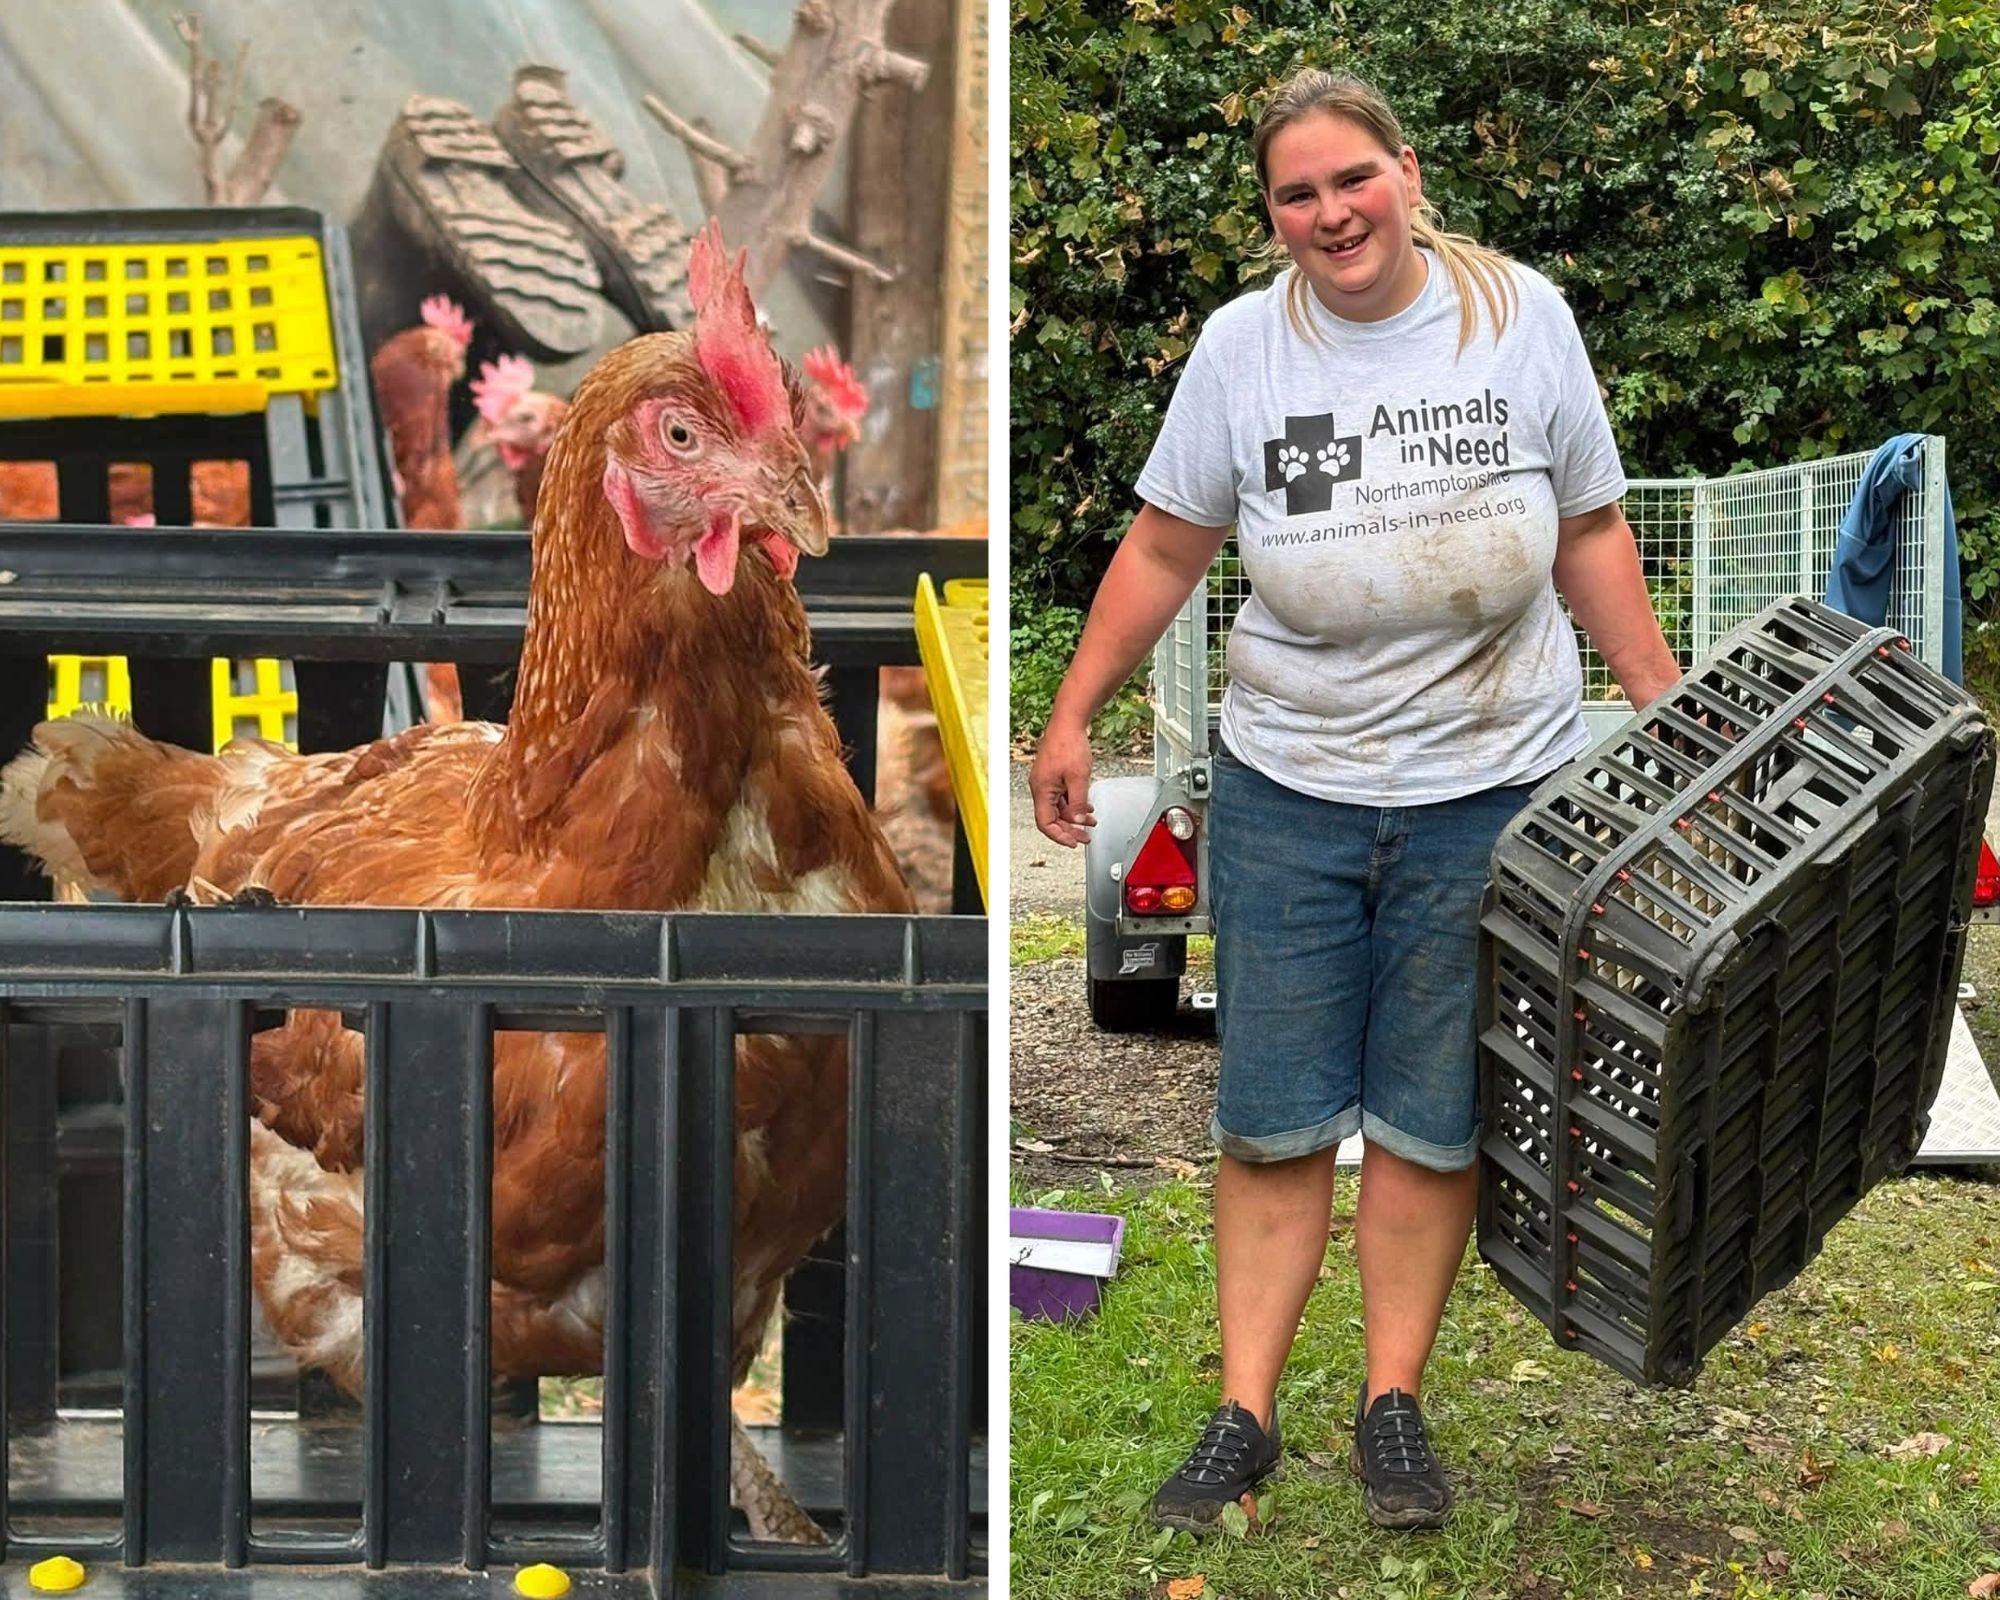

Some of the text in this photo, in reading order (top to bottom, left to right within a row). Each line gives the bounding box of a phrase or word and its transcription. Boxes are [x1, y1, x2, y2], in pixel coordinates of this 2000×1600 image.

[1369, 388, 1508, 438] Animals
[1401, 432, 1510, 467] in Need
[1355, 470, 1510, 505] Northamptonshire
[1261, 496, 1526, 548] www.animals-in-need.org
